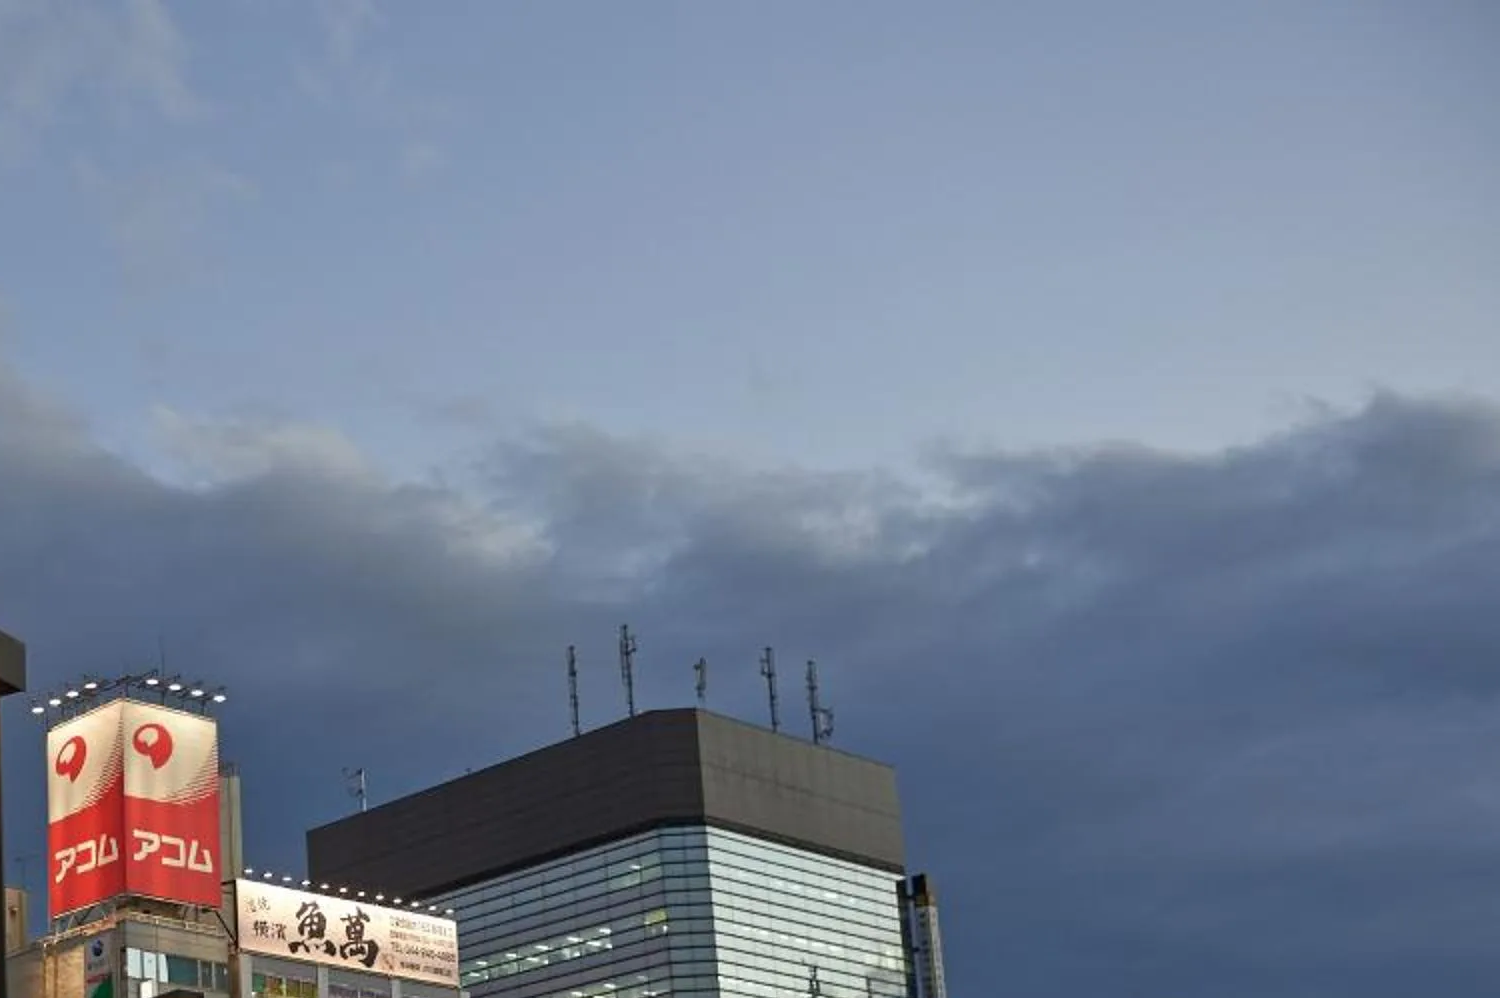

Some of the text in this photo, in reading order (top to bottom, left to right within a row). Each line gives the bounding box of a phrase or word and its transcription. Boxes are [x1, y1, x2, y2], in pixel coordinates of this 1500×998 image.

[54, 833, 119, 884] アコム
[132, 828, 213, 874] アコム
